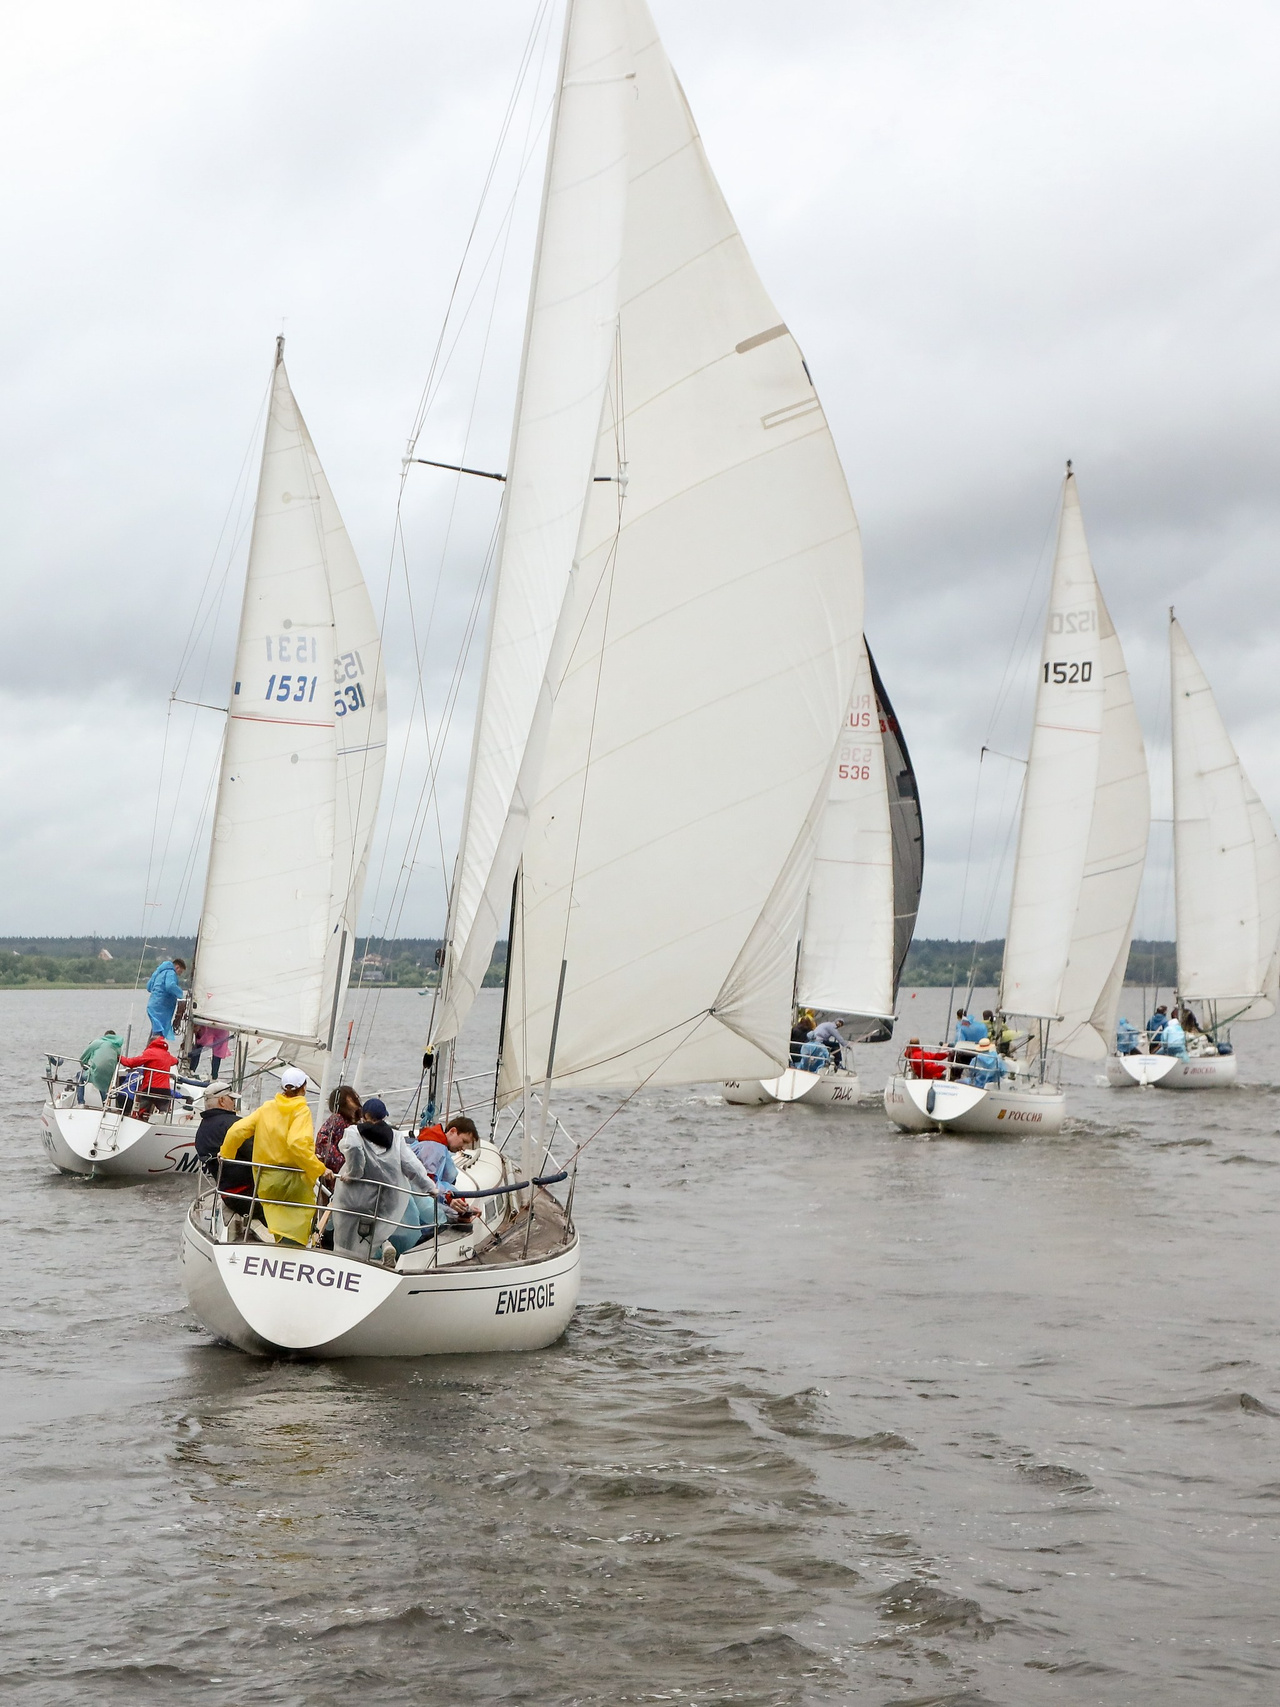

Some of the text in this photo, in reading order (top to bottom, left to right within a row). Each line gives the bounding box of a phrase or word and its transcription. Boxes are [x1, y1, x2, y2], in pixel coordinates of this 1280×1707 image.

[1044, 662, 1092, 684] 1520
[265, 674, 317, 702] 1531
[845, 713, 870, 727] US
[839, 765, 870, 780] 536
[1008, 1110, 1042, 1122] РОССИЯ
[243, 1256, 362, 1293] ENERGIE
[495, 1282, 555, 1316] ENERGIE
